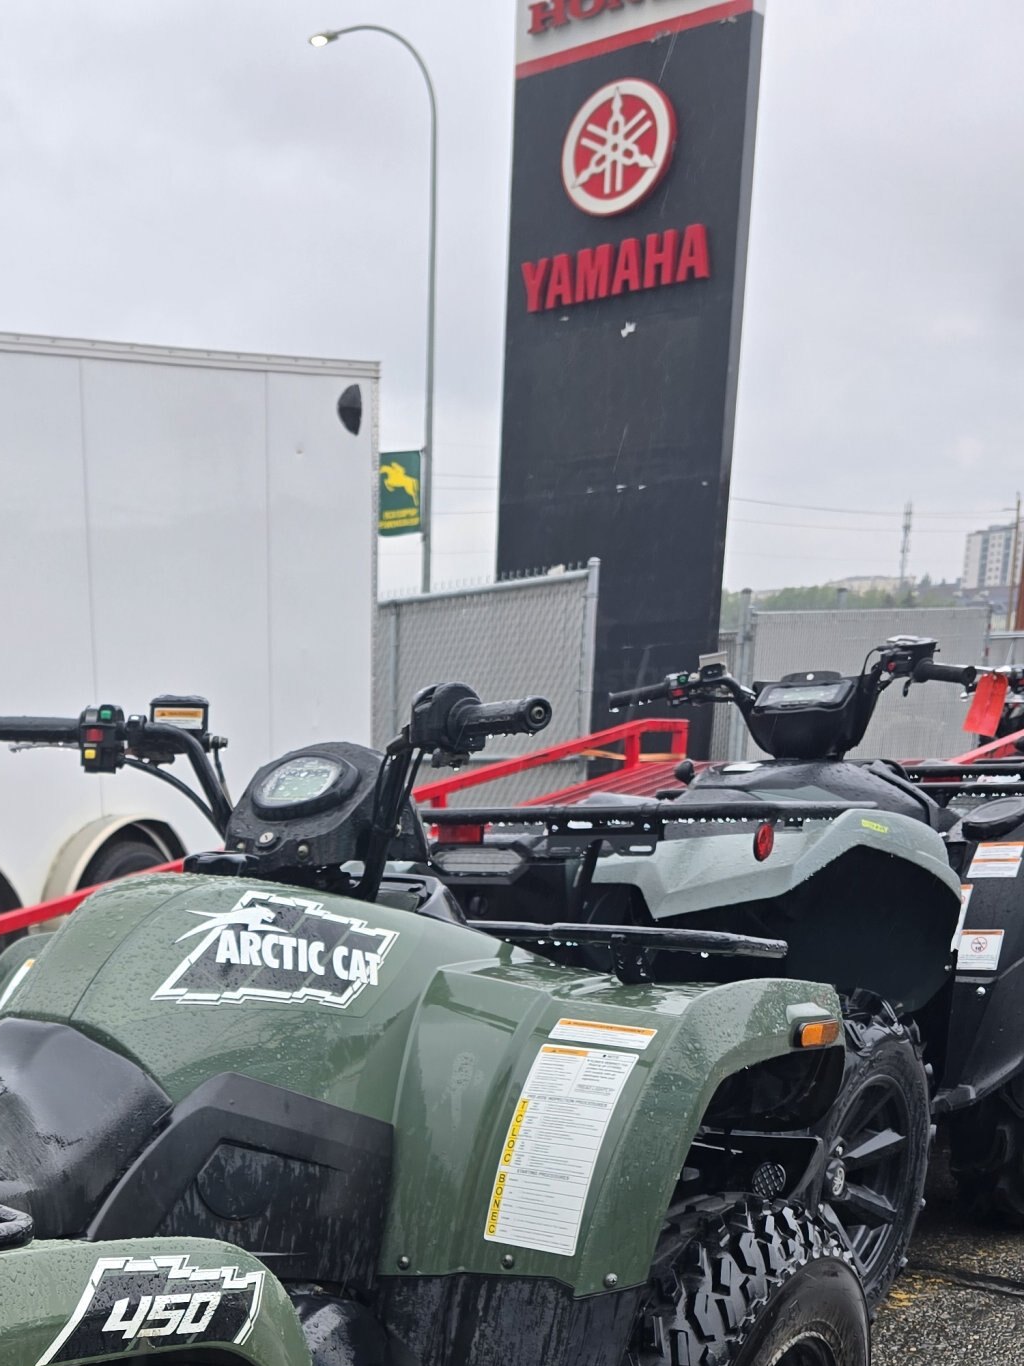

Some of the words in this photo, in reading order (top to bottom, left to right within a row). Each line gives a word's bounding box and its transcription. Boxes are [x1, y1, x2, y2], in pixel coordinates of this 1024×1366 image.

[520, 223, 711, 313] YAMAHA
[215, 929, 326, 976] ARCTIC
[332, 945, 381, 986] CAT
[101, 1291, 222, 1340] 450
